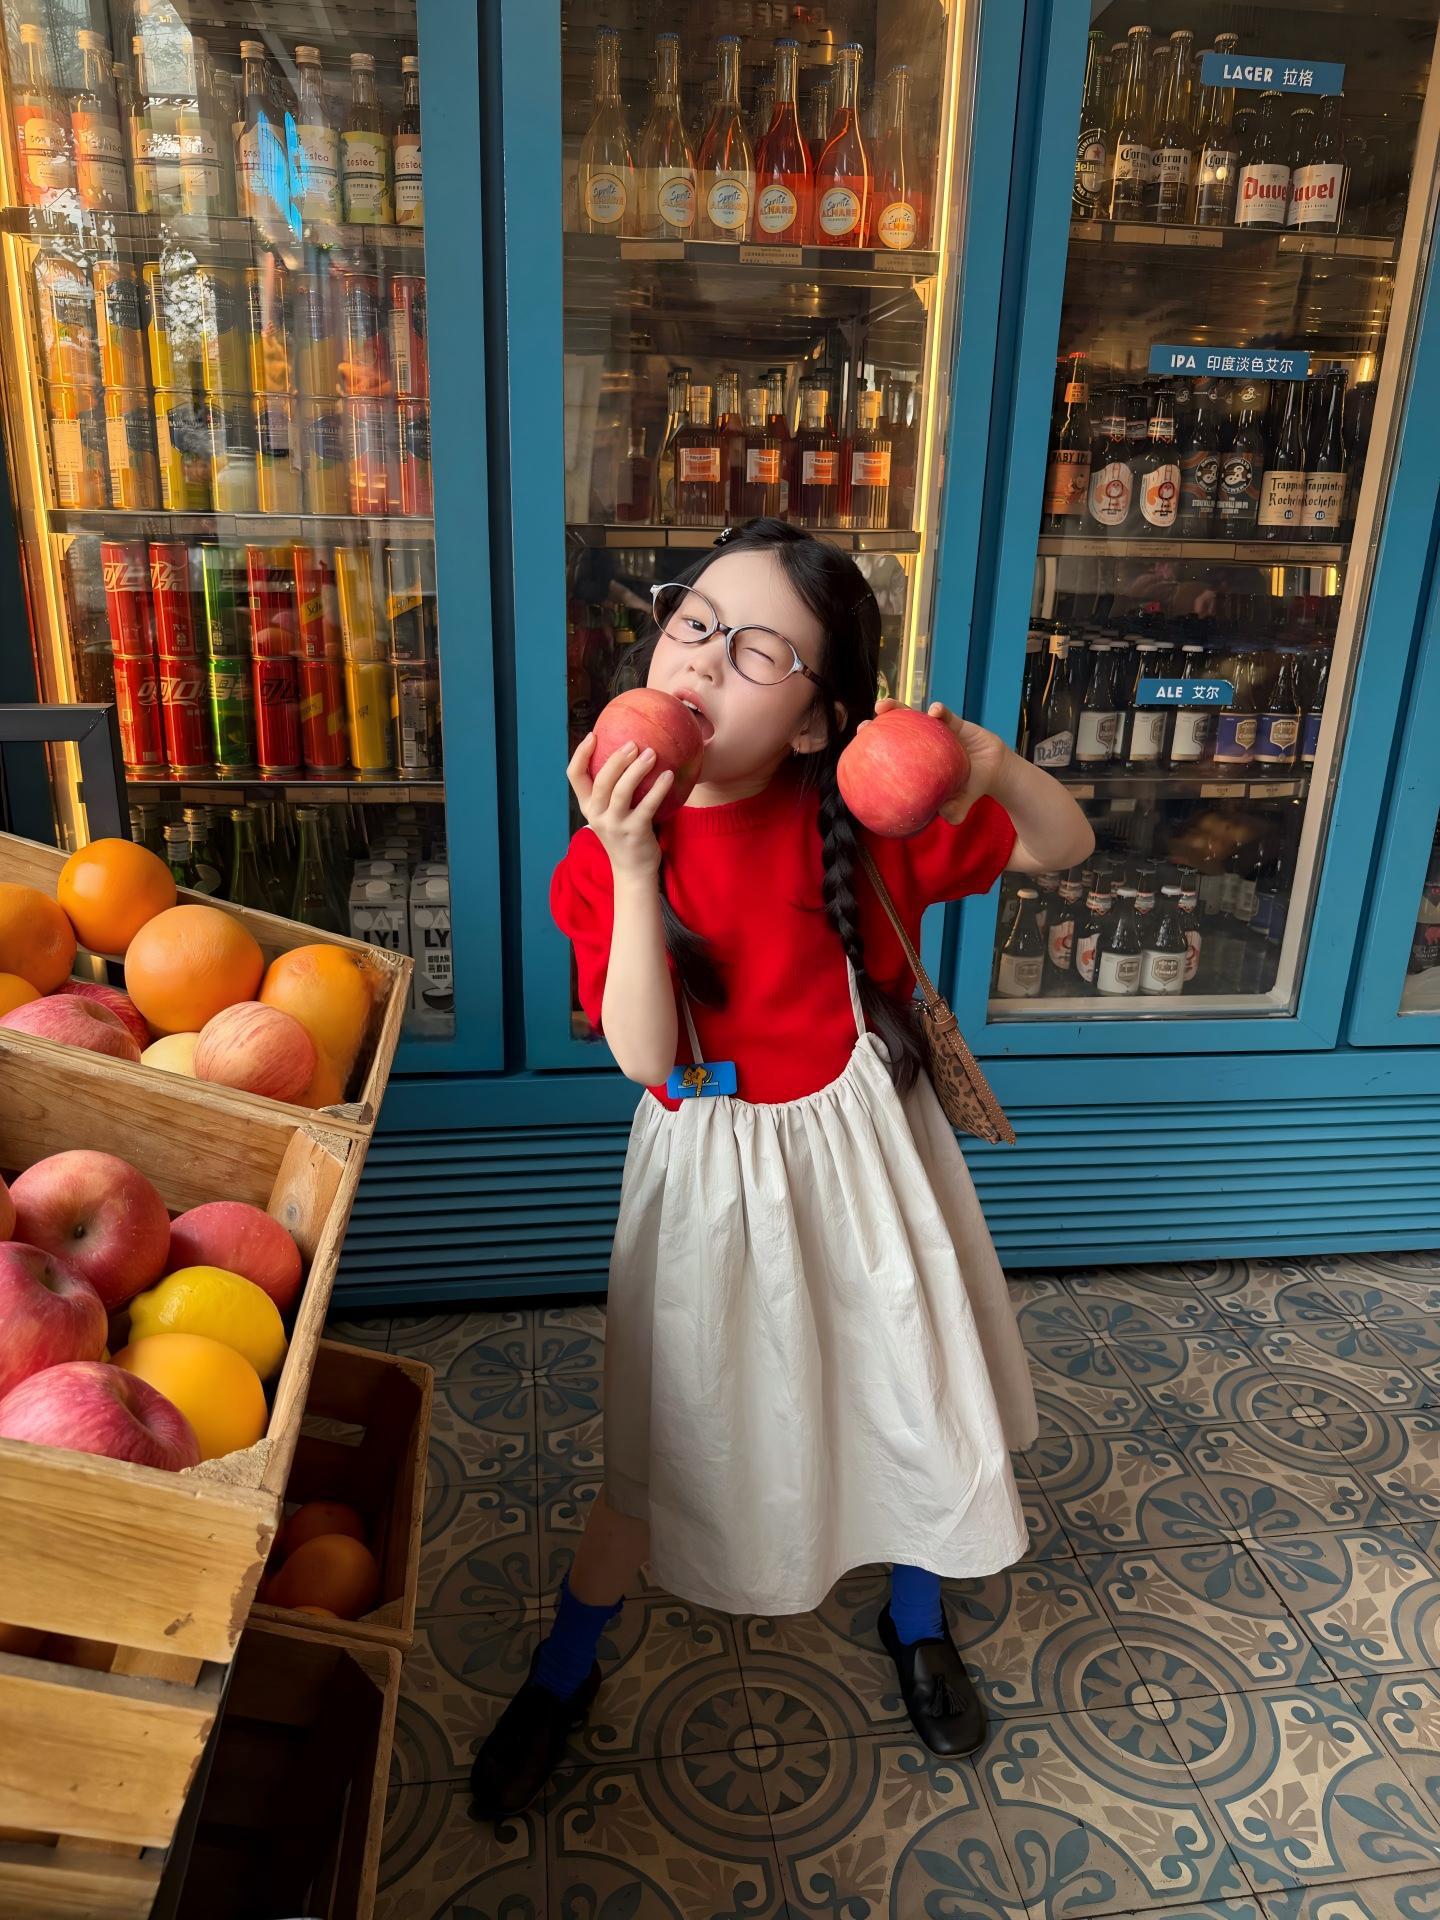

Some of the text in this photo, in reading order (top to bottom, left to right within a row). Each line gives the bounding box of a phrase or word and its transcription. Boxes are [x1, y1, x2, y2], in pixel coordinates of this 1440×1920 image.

[1223, 64, 1314, 88] LAGER 拉格
[1243, 177, 1286, 201] Duve
[1291, 177, 1334, 202] uvel
[1170, 354, 1294, 374] IPA 印度淡色艾尔
[1156, 686, 1219, 700] ALE 艾尔
